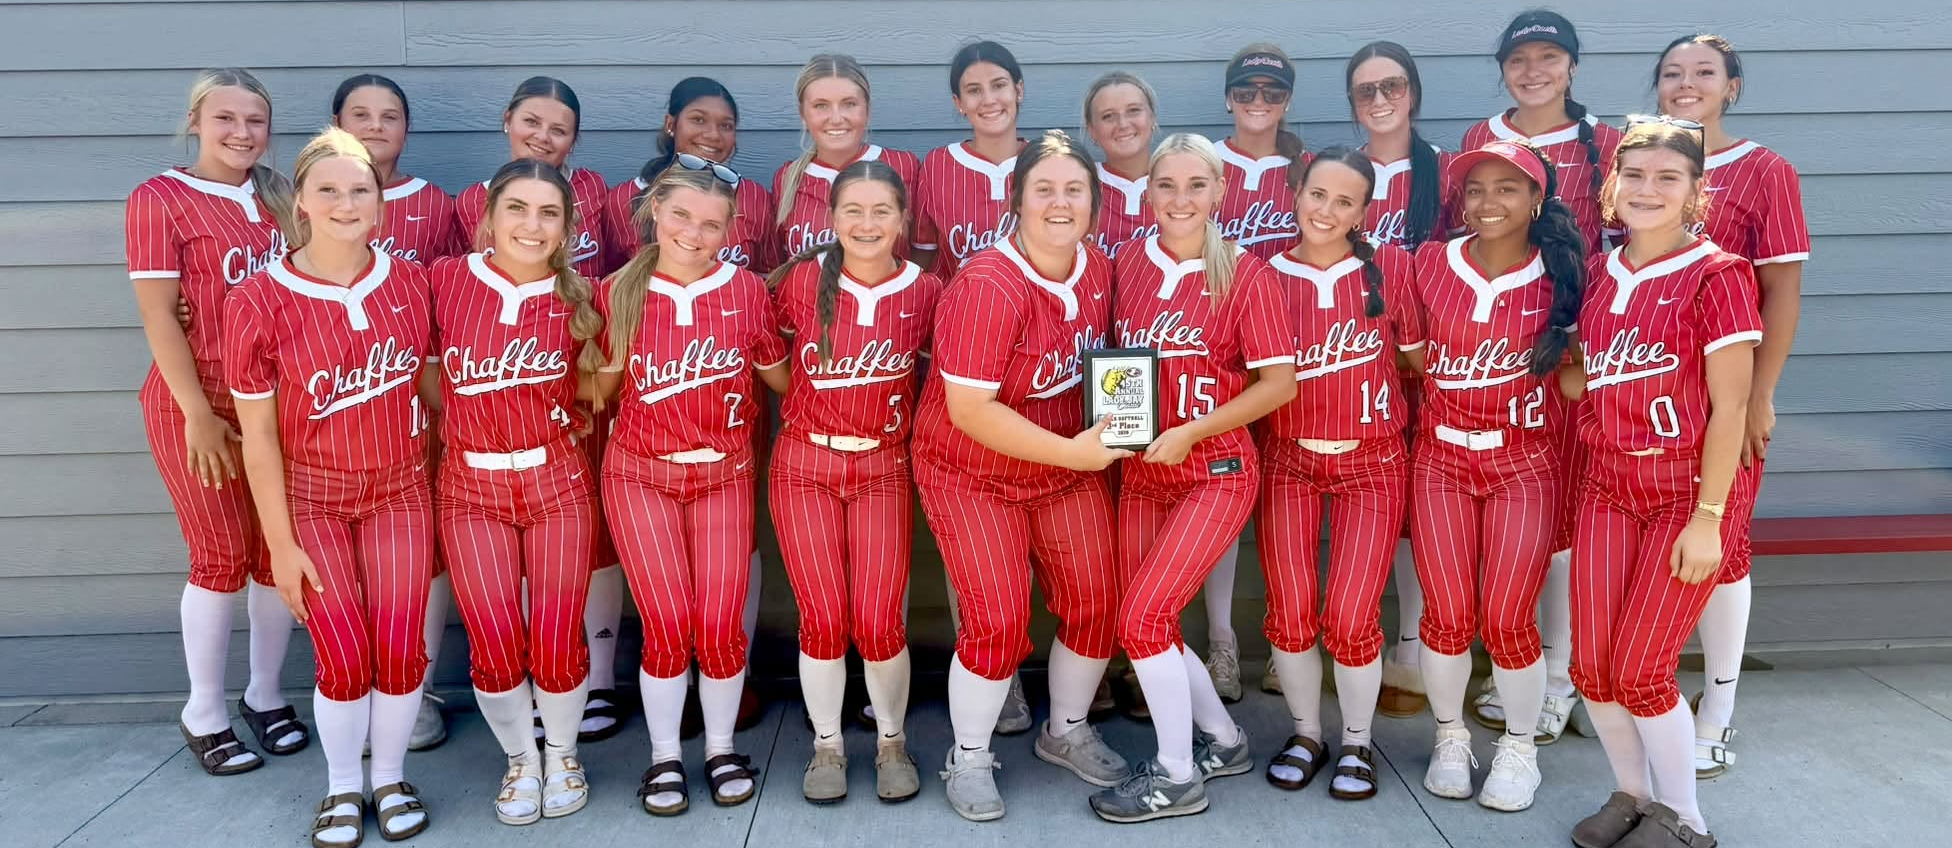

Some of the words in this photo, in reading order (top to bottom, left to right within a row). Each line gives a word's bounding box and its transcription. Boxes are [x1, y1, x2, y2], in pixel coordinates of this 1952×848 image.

[948, 210, 1018, 268] Chaf
[1213, 199, 1300, 247] haffee
[222, 228, 289, 285] Chaf
[443, 336, 568, 396] Chaffee
[629, 335, 745, 405] Chaffee
[1026, 324, 1106, 399] Chaf
[1294, 317, 1384, 381] haffee
[1425, 337, 1533, 390] Chaffee
[1580, 325, 1680, 392] haffee
[410, 395, 429, 438] 1
[1176, 373, 1217, 420] 15
[1359, 379, 1391, 424] 14
[1507, 385, 1545, 429] 12
[1649, 395, 1681, 438] 0
[1119, 421, 1140, 430] Place
